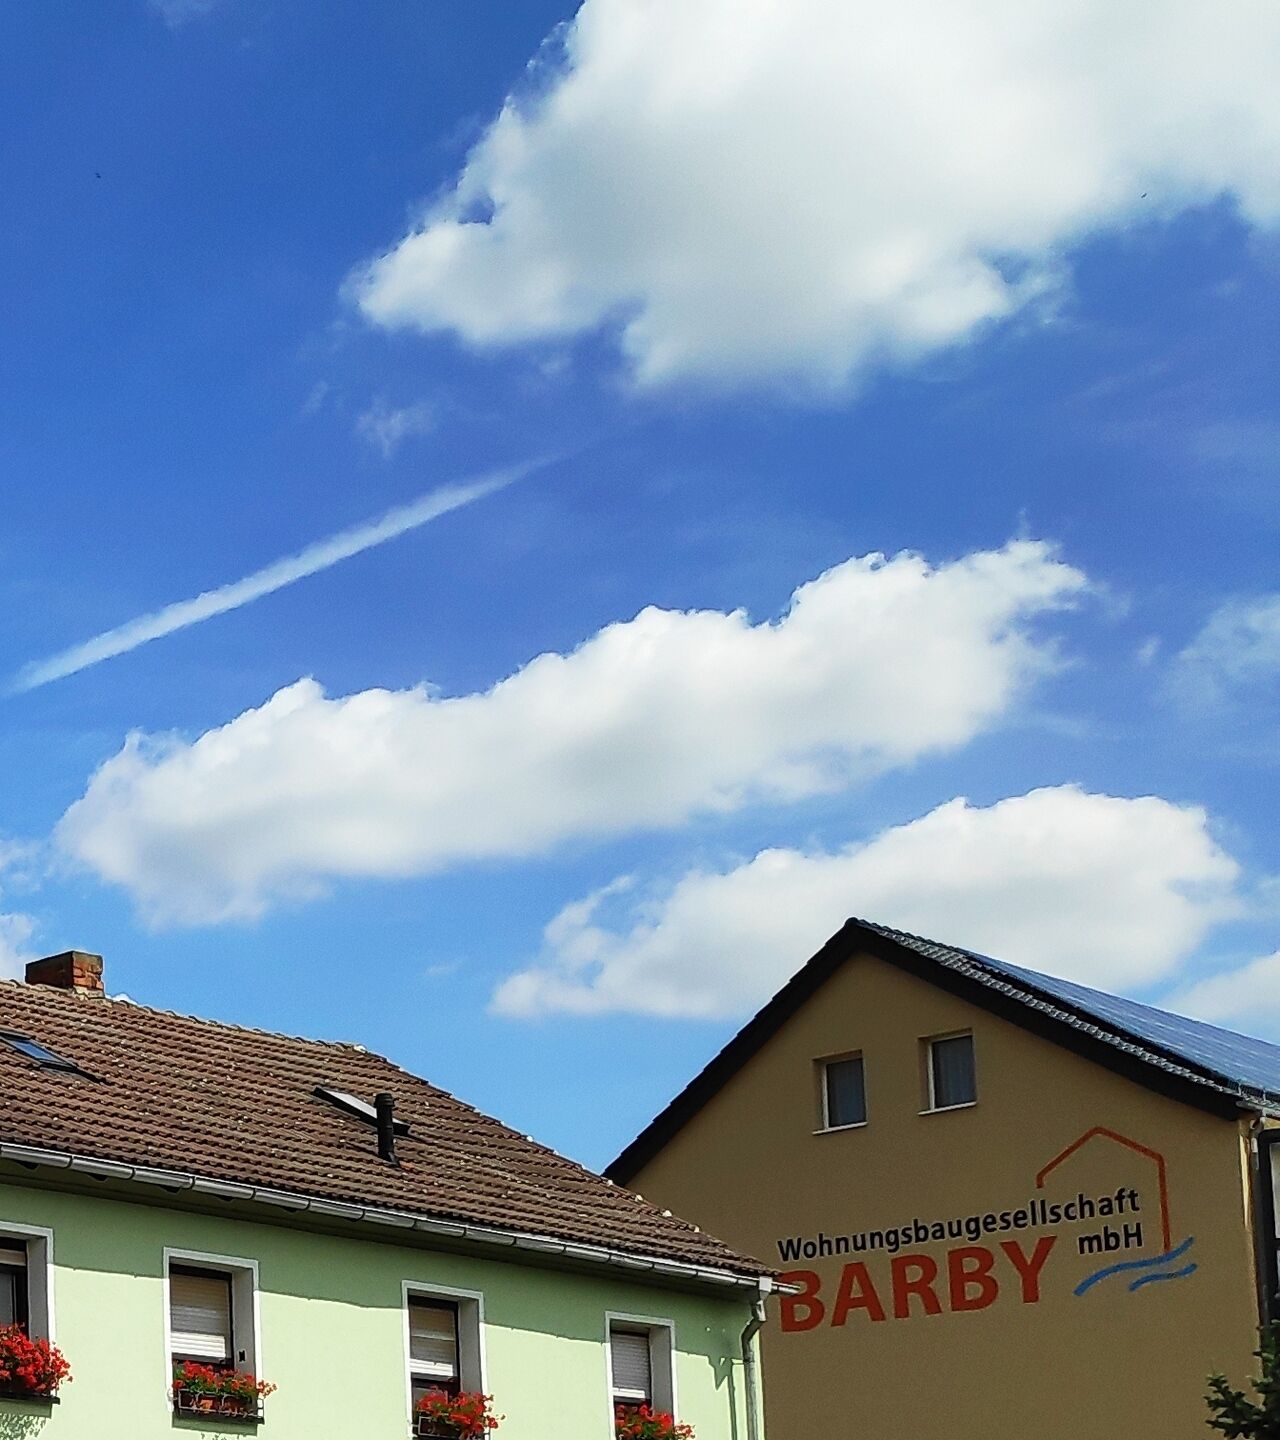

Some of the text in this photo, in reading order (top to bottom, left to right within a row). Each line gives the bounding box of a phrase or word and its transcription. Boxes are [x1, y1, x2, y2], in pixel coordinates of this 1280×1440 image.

[777, 1188, 1140, 1262] Wohnungsbaugesellschaft
[1077, 1222, 1143, 1255] mbH
[779, 1235, 1058, 1333] BARBY
